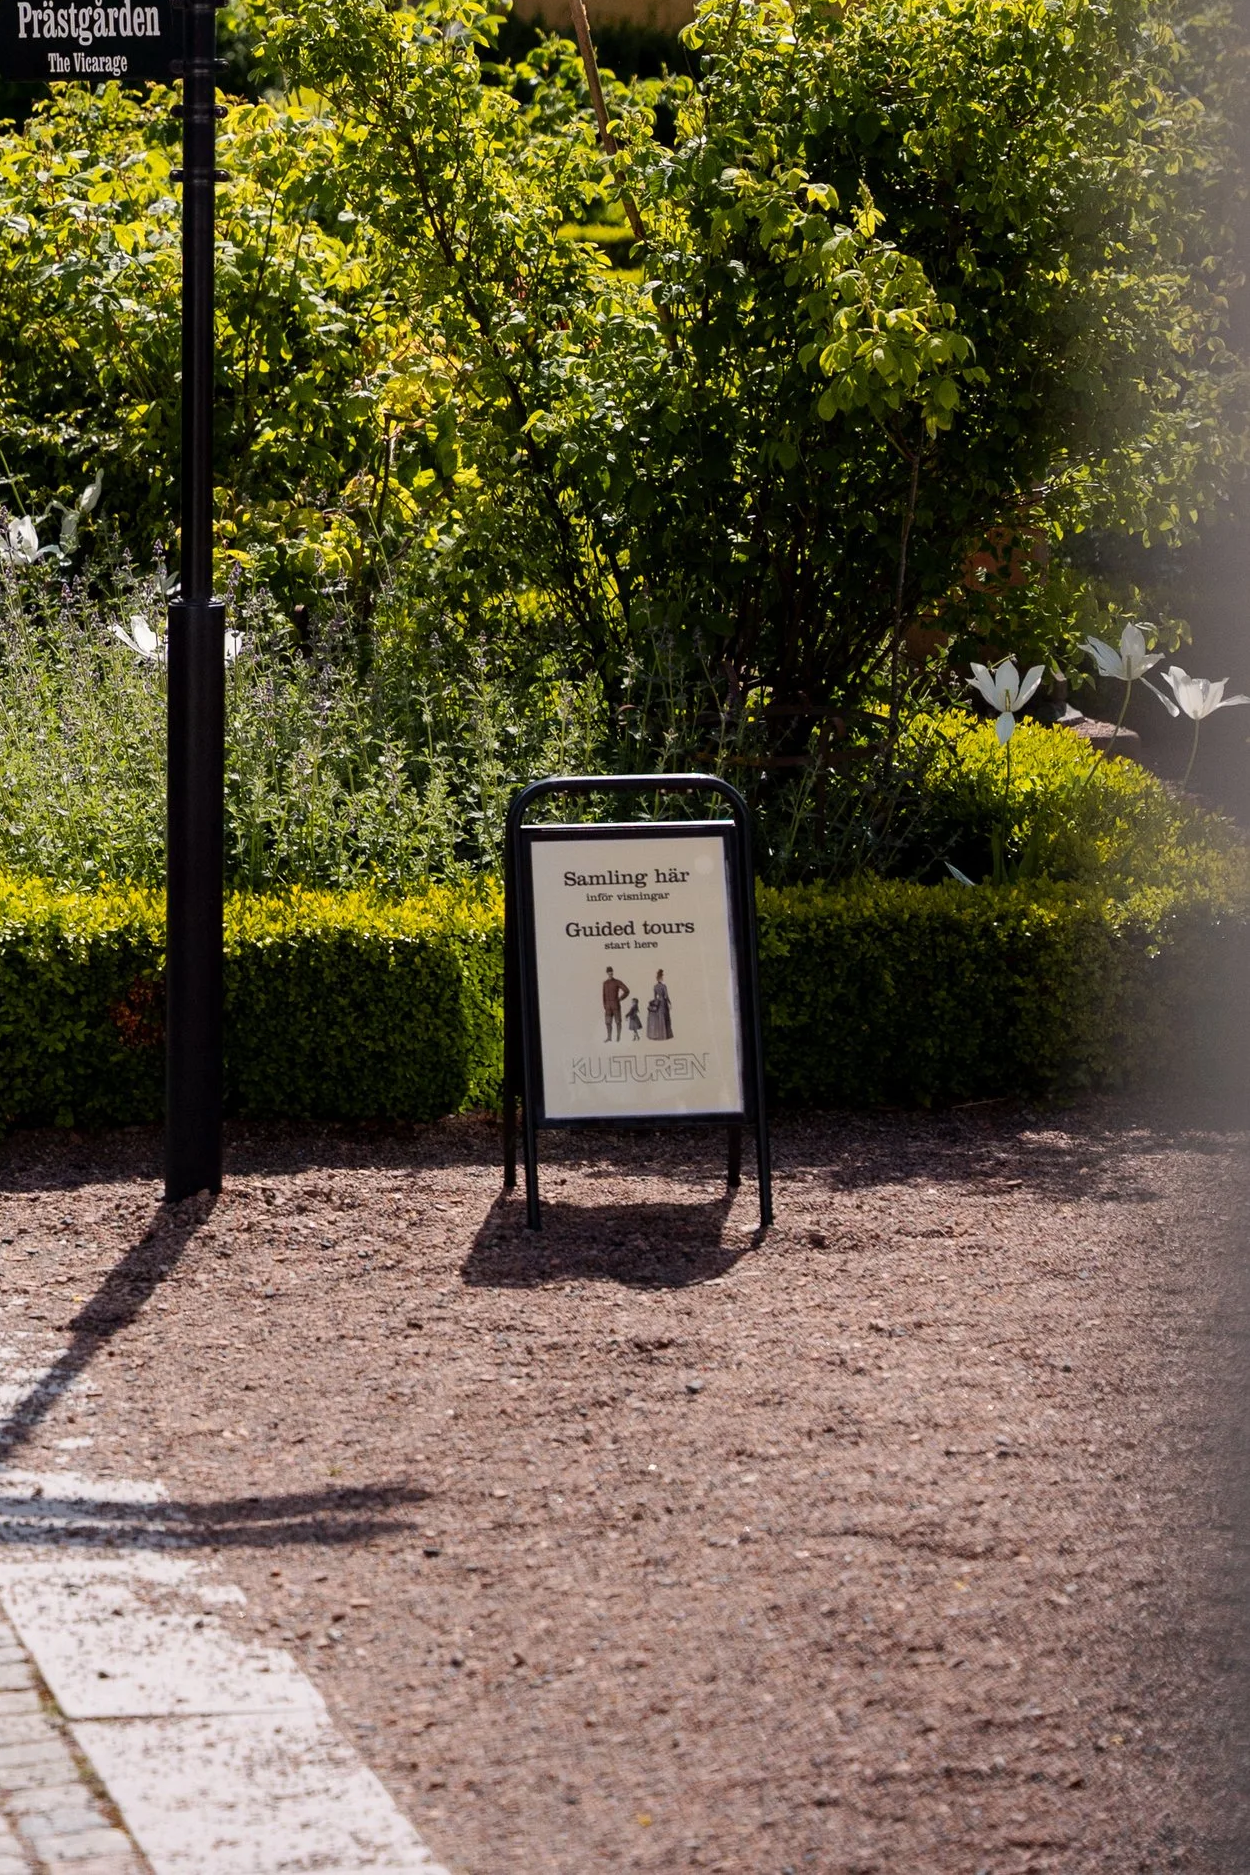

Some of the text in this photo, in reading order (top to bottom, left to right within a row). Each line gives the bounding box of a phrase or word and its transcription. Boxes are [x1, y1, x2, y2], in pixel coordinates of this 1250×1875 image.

[48, 52, 128, 76] The Vicarage
[564, 868, 690, 888] Samling här
[587, 891, 670, 902] inför visningar
[566, 921, 694, 937] Guided tours
[605, 941, 630, 950] start
[569, 1053, 709, 1084] KULTUREN
